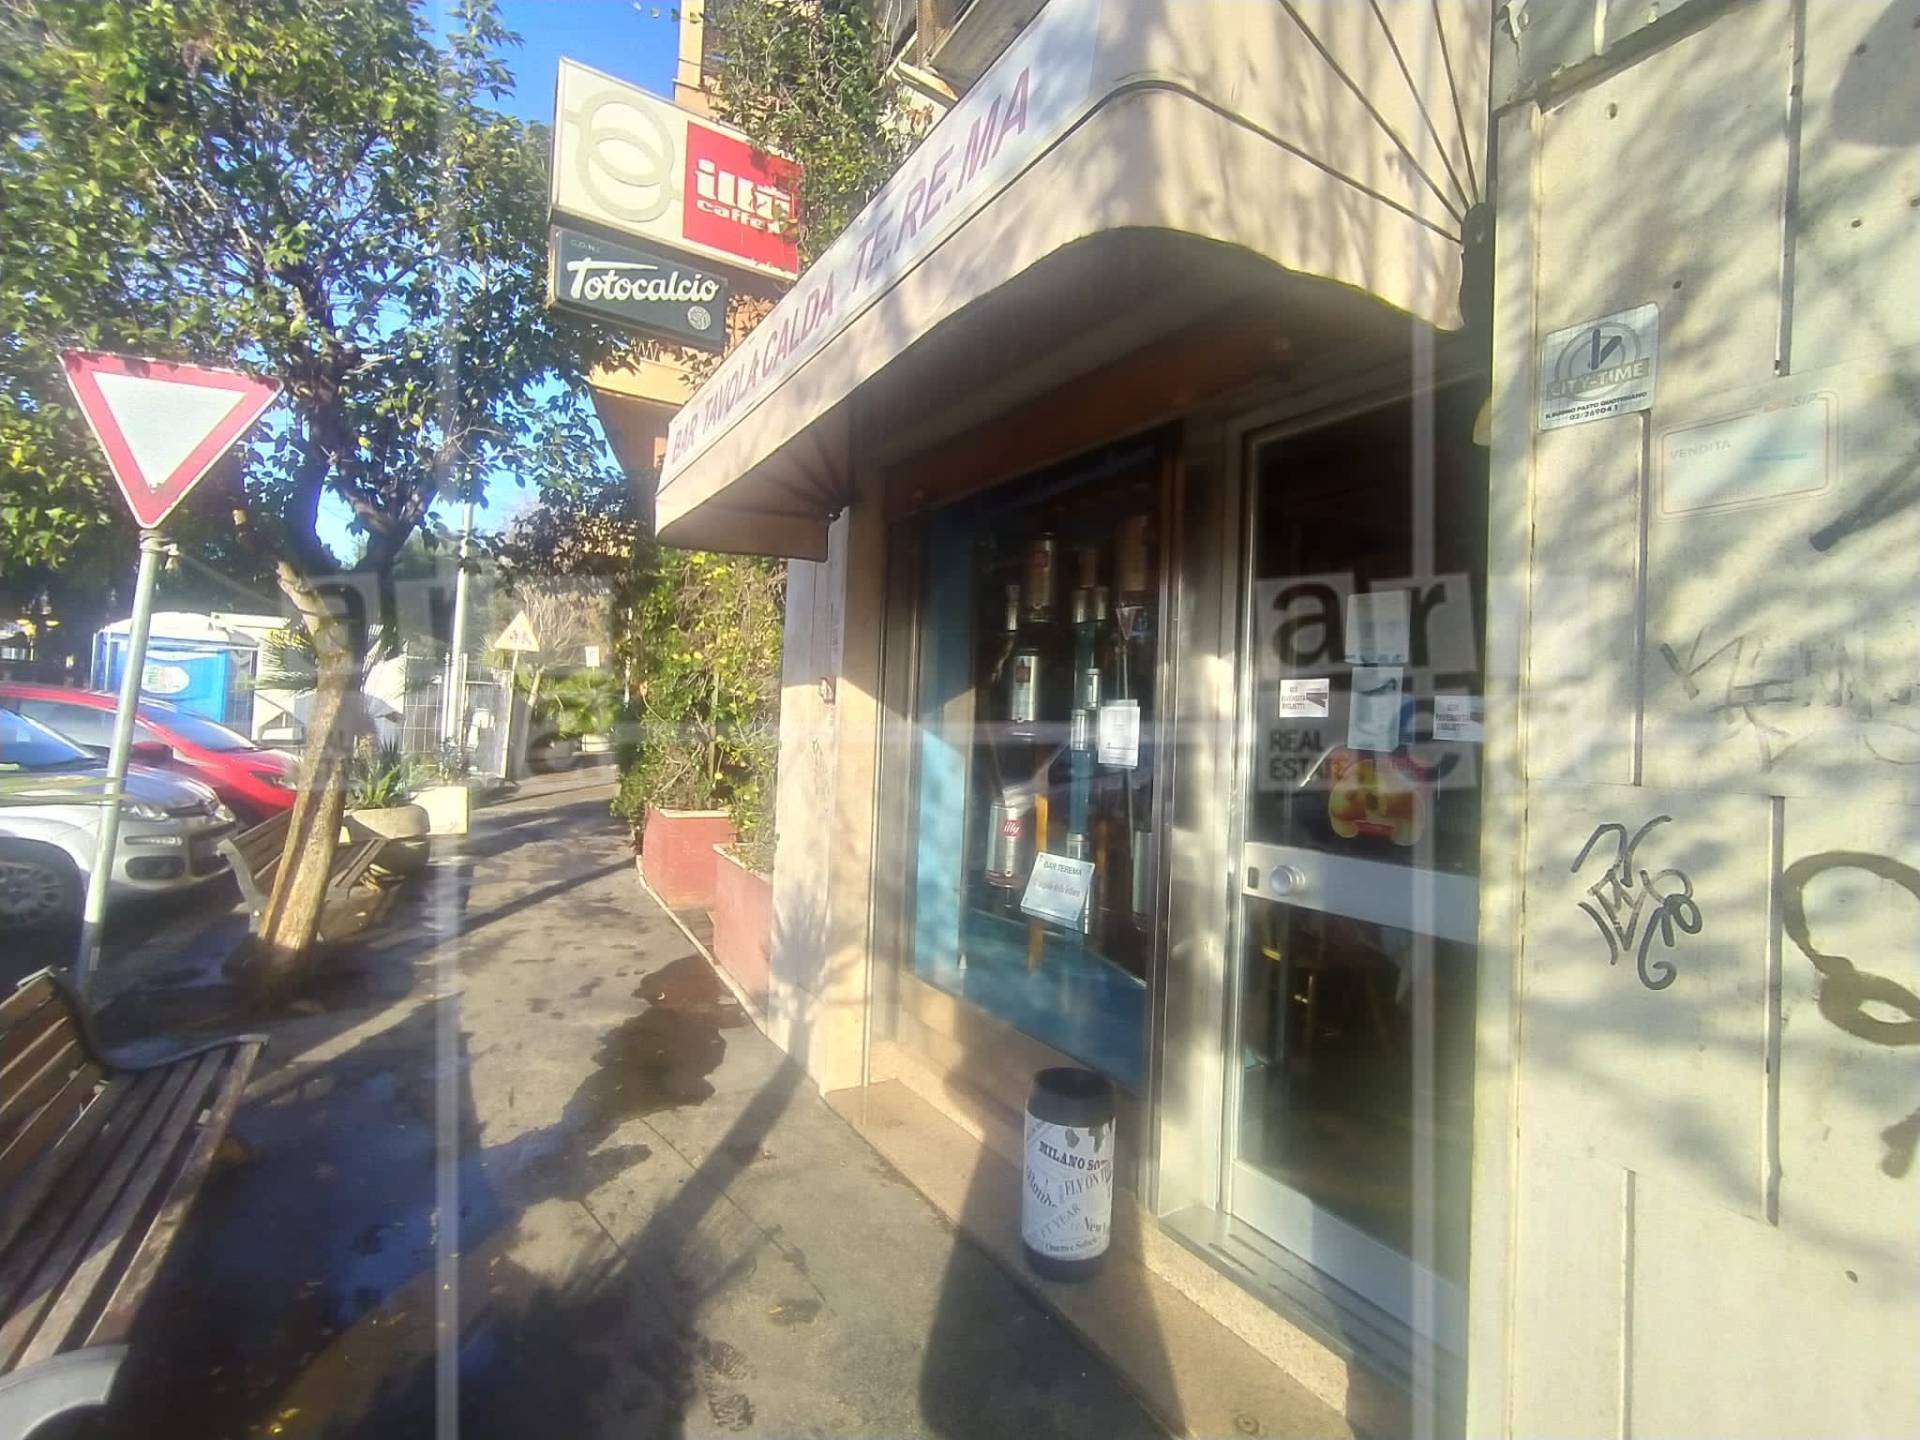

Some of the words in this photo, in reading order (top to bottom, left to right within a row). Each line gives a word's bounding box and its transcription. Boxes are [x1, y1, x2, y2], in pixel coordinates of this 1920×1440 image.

[566, 256, 720, 303] Totocalcio
[671, 413, 699, 465] BAR
[703, 357, 760, 438] TAVOLA
[761, 271, 835, 377] CALDA
[1577, 402, 1599, 412] PASTO
[1038, 1141, 1085, 1169] MILANO
